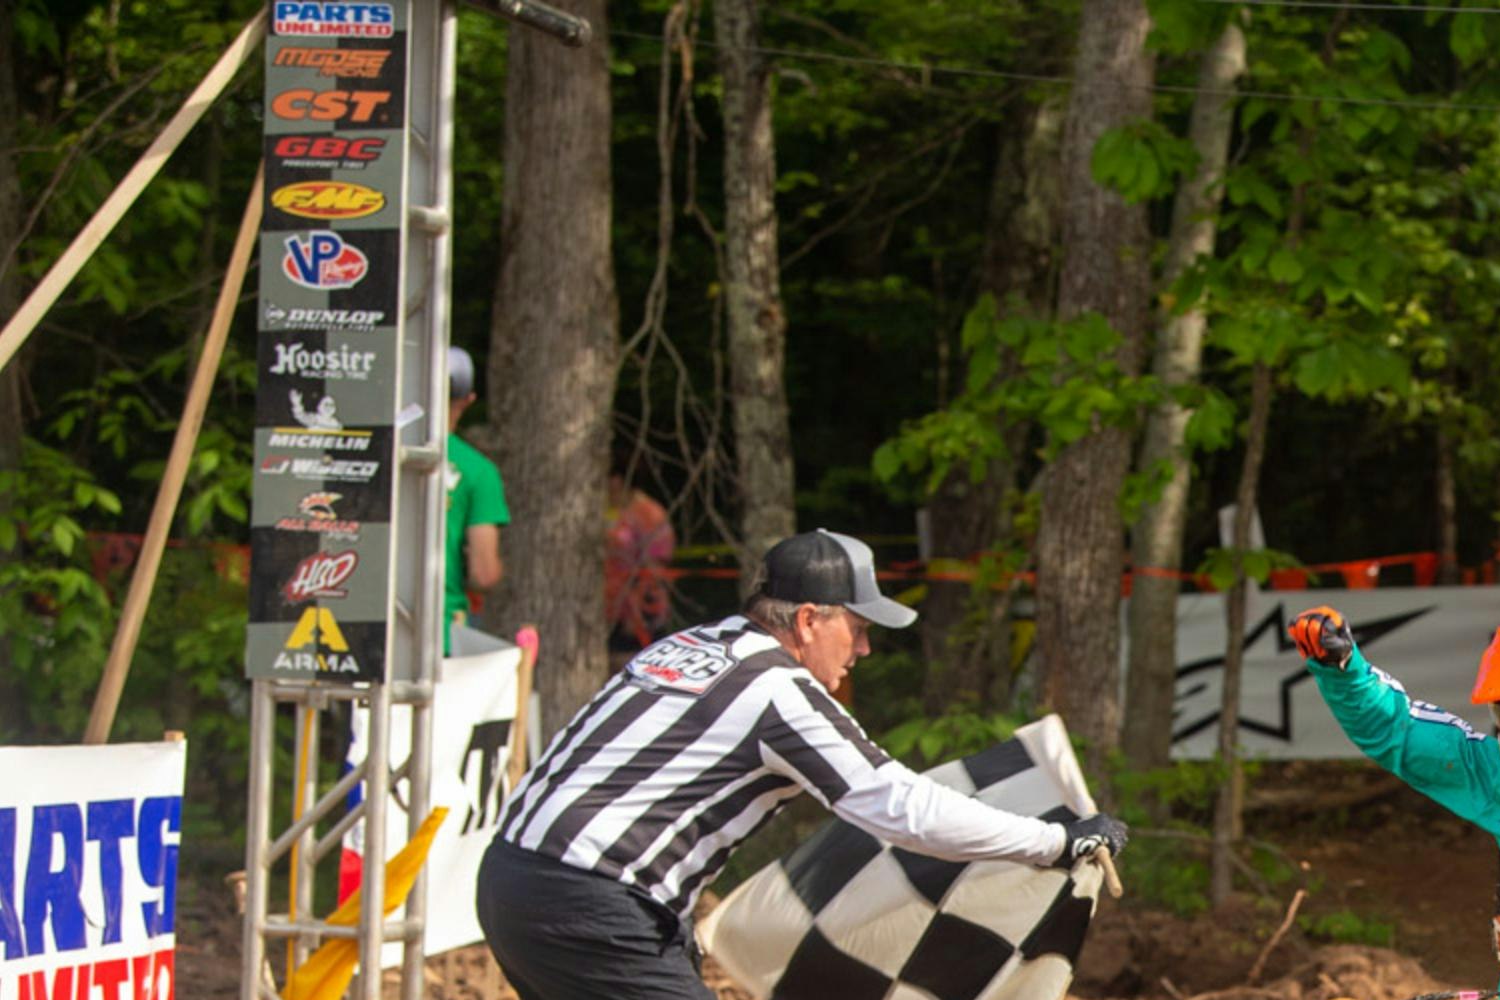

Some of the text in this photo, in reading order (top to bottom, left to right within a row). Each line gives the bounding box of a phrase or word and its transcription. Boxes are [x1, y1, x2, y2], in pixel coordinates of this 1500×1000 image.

[277, 3, 391, 22] PARTS
[276, 22, 391, 35] UNLIMITED
[271, 87, 391, 122] CST
[274, 136, 386, 160] GBC
[272, 186, 384, 211] FMF
[288, 234, 342, 285] VP
[287, 308, 384, 325] DUNLOP
[269, 342, 375, 374] Hoosier
[268, 434, 370, 450] MICHELIN
[274, 652, 360, 673] ARMA
